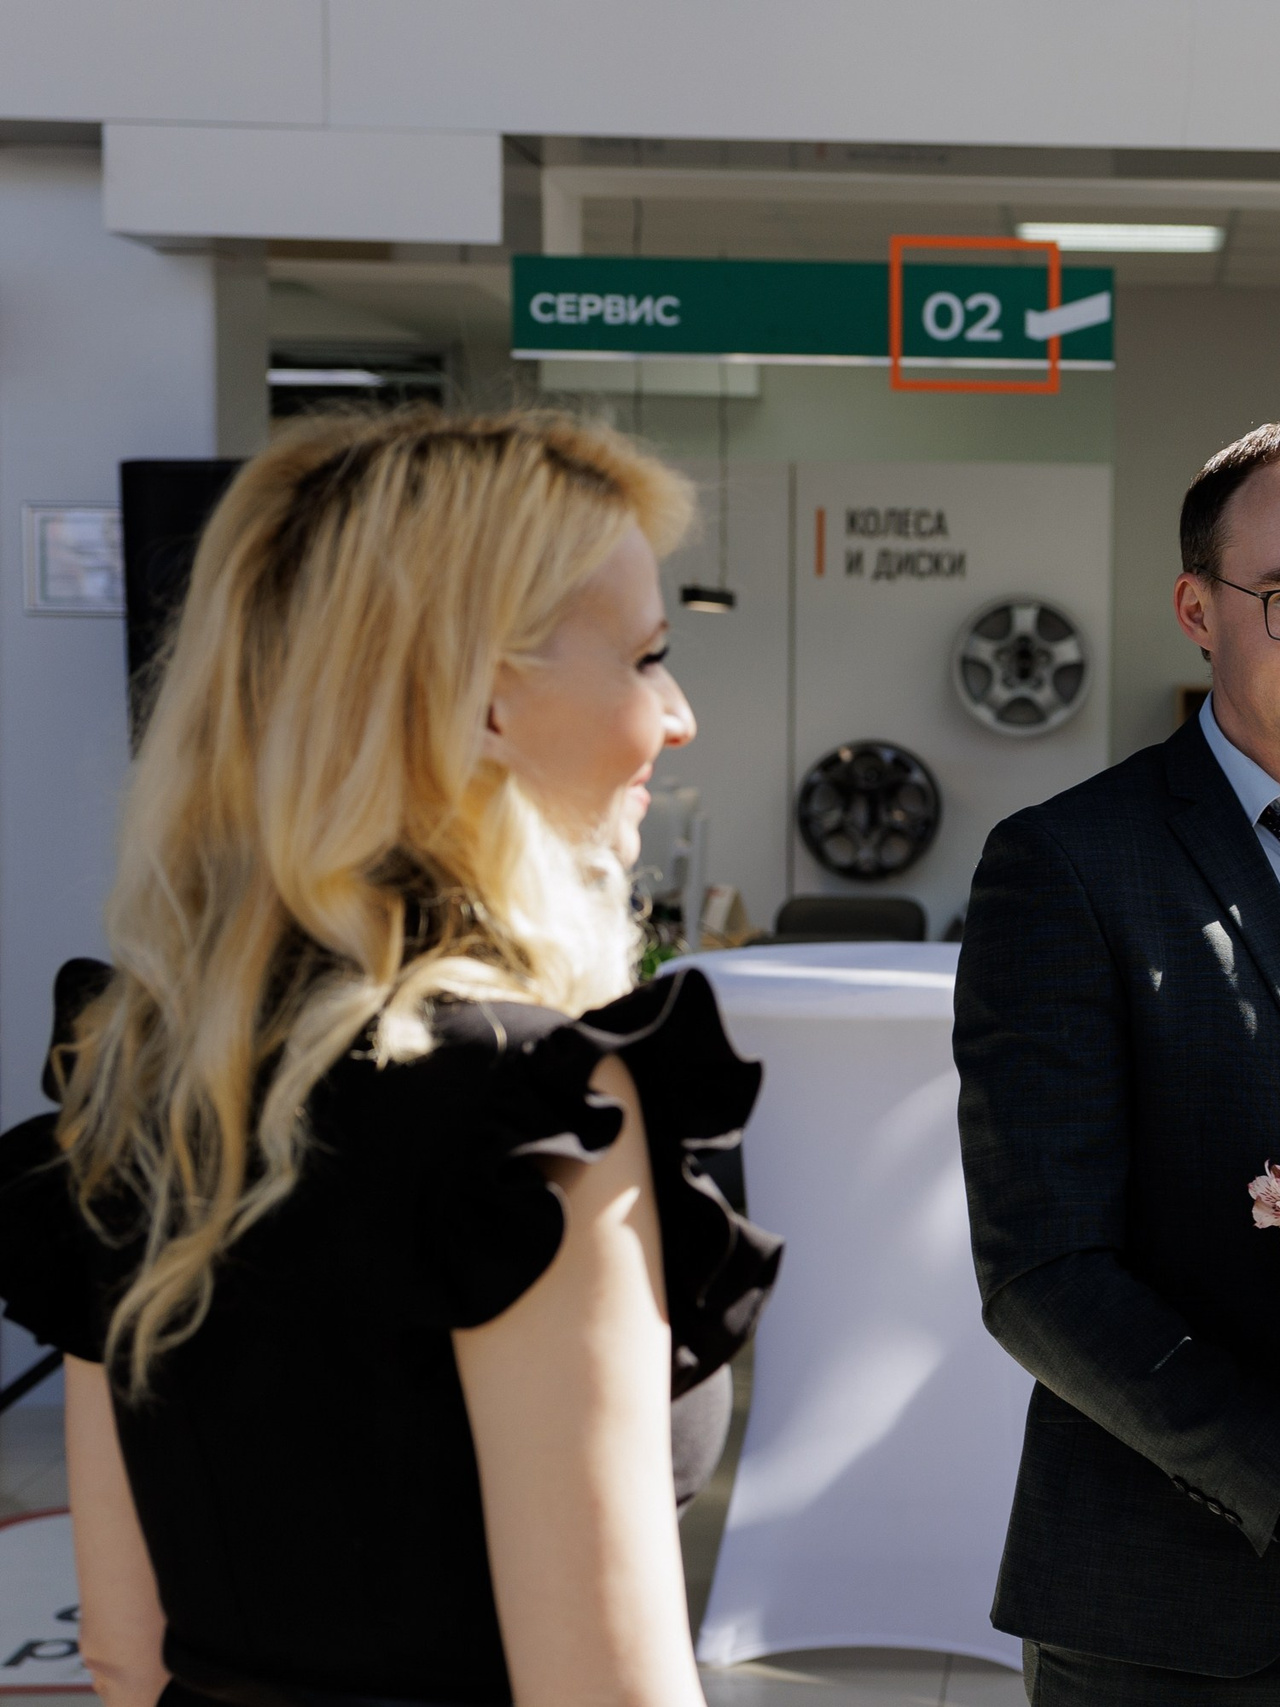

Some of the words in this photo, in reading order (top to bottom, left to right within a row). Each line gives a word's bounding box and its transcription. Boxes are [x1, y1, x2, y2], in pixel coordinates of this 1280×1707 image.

[529, 292, 681, 327] СЕРВИС
[922, 291, 1002, 341] 02
[845, 508, 949, 538] КОЛЕСА
[846, 549, 863, 577] И
[872, 550, 967, 582] ДИСКИ
